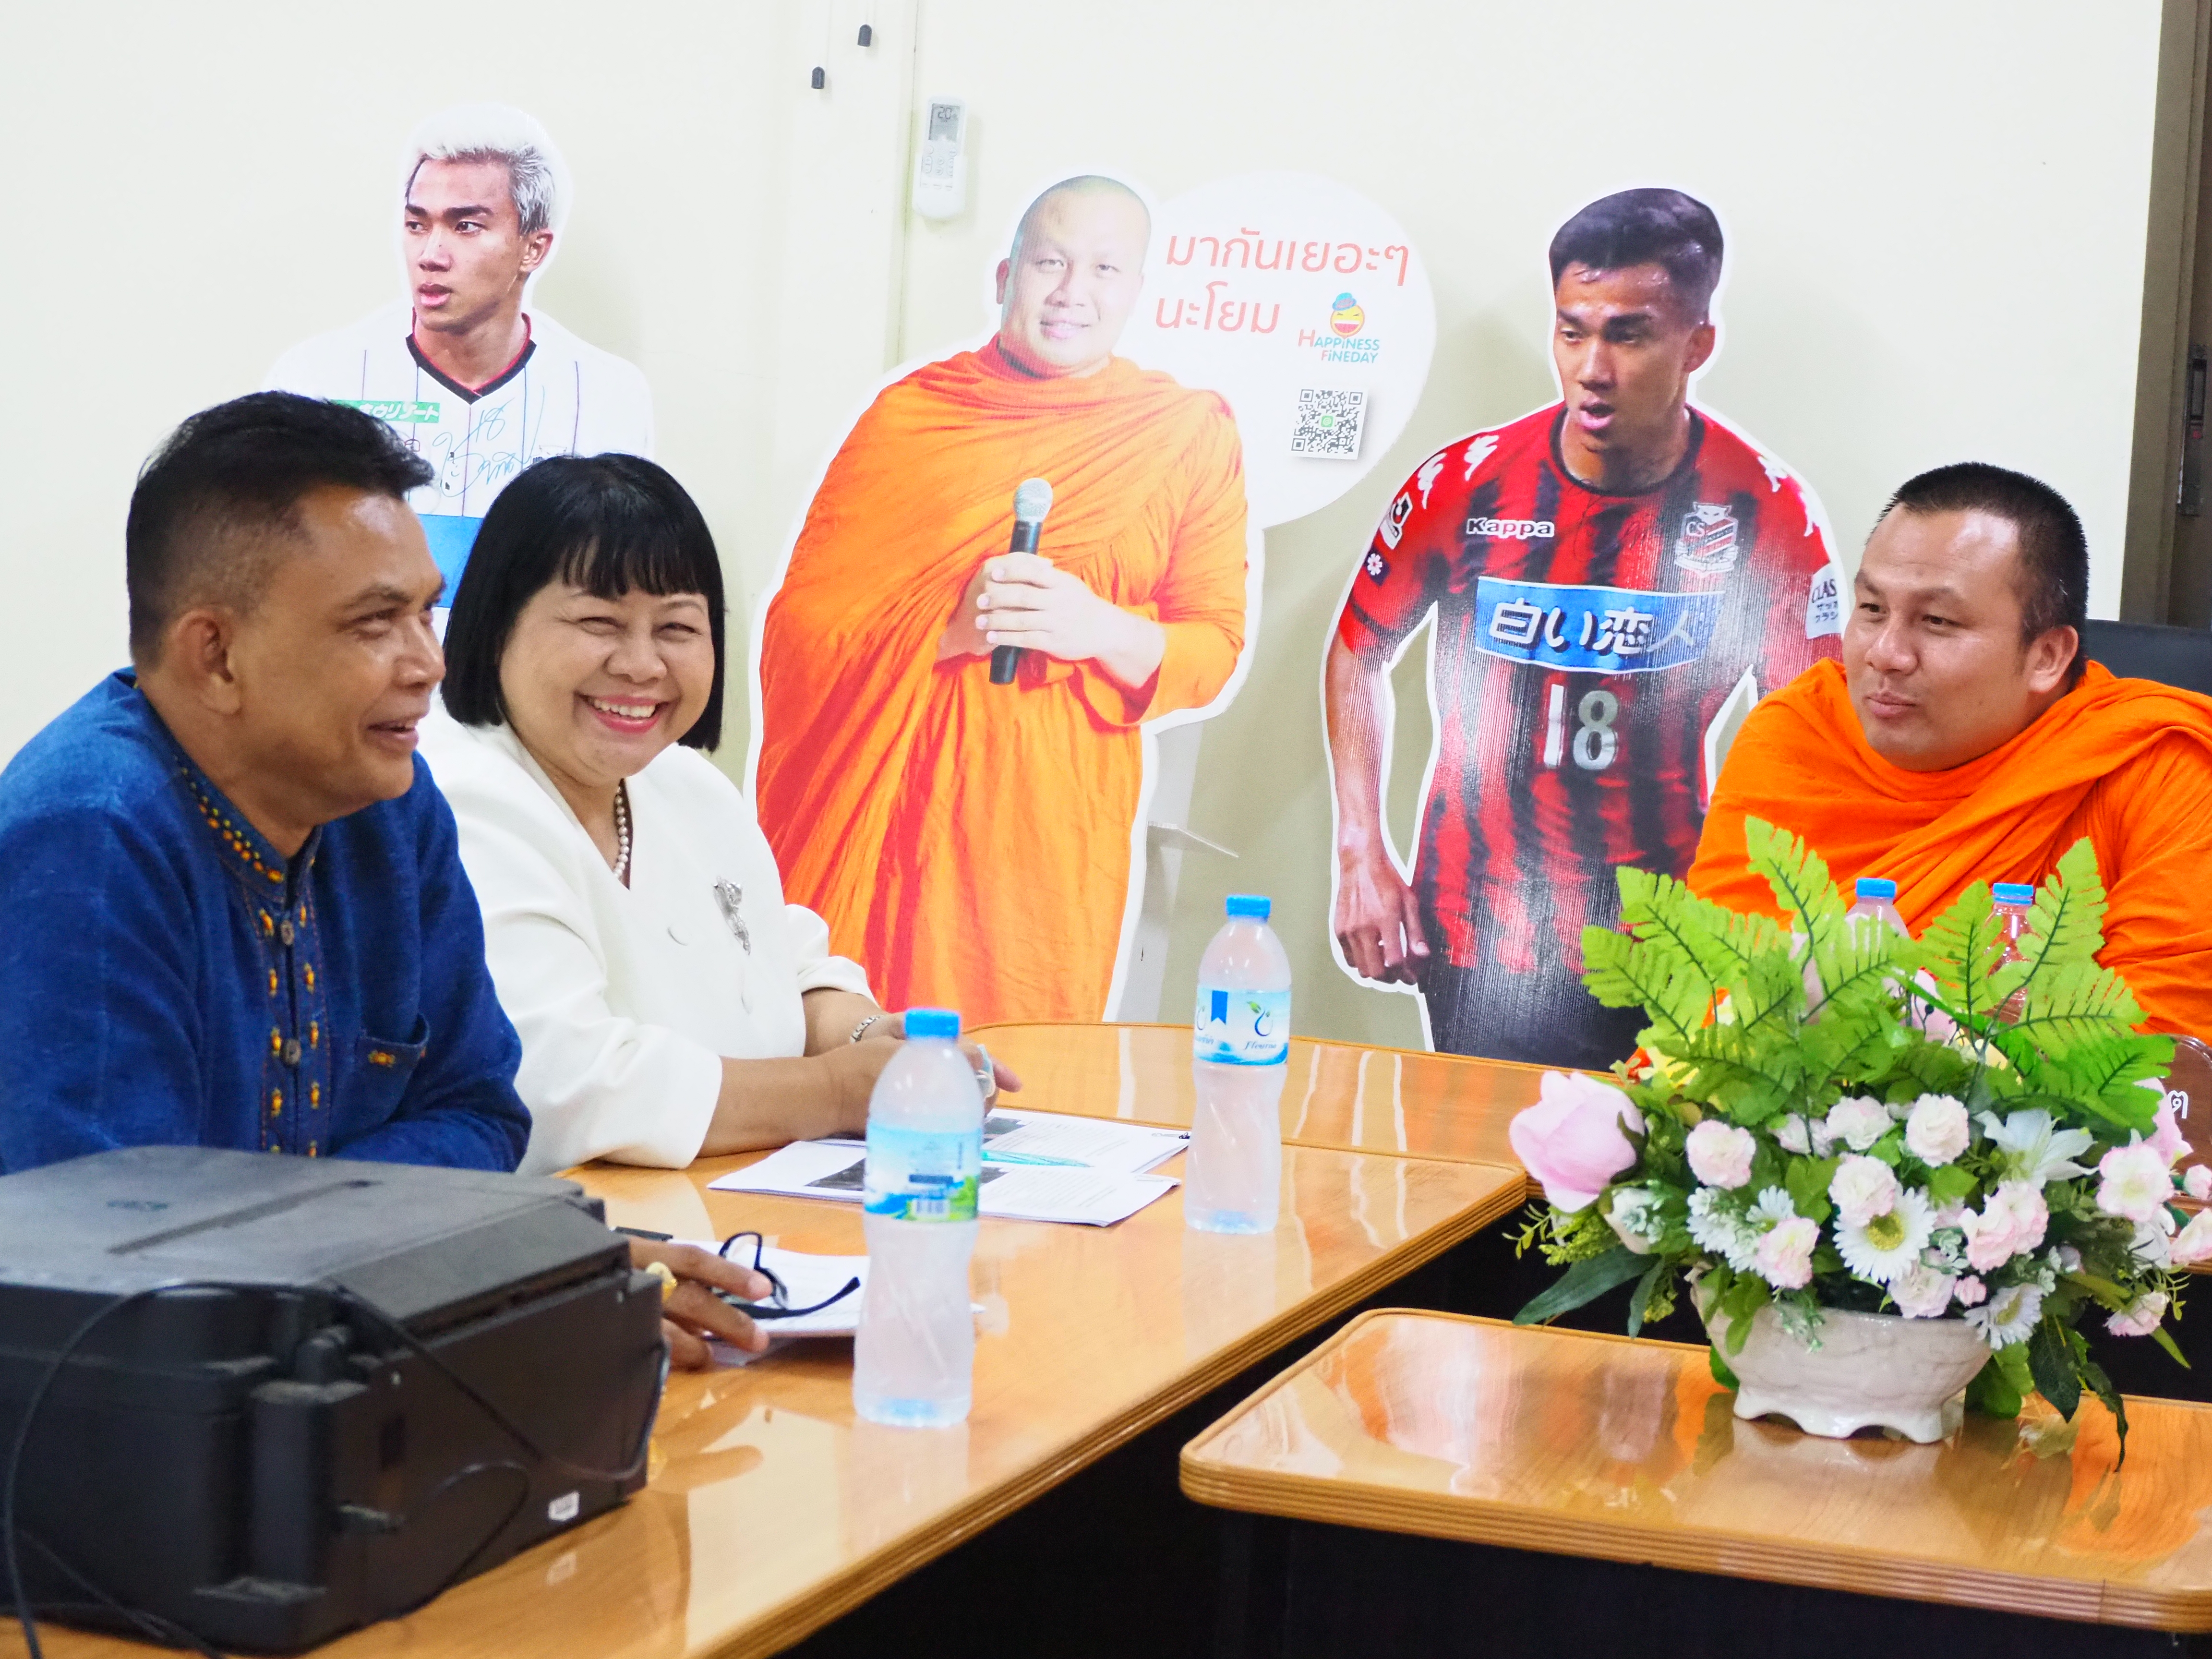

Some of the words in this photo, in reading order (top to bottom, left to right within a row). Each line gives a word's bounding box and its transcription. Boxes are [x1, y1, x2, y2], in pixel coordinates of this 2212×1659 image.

[938, 106, 952, 120] 20
[1166, 227, 1409, 287] มากันเยอะๆ
[1155, 280, 1281, 334] นะโยม
[1467, 518, 1553, 538] Kappa
[1489, 597, 1695, 655] 白い恋人
[1543, 684, 1620, 770] 18
